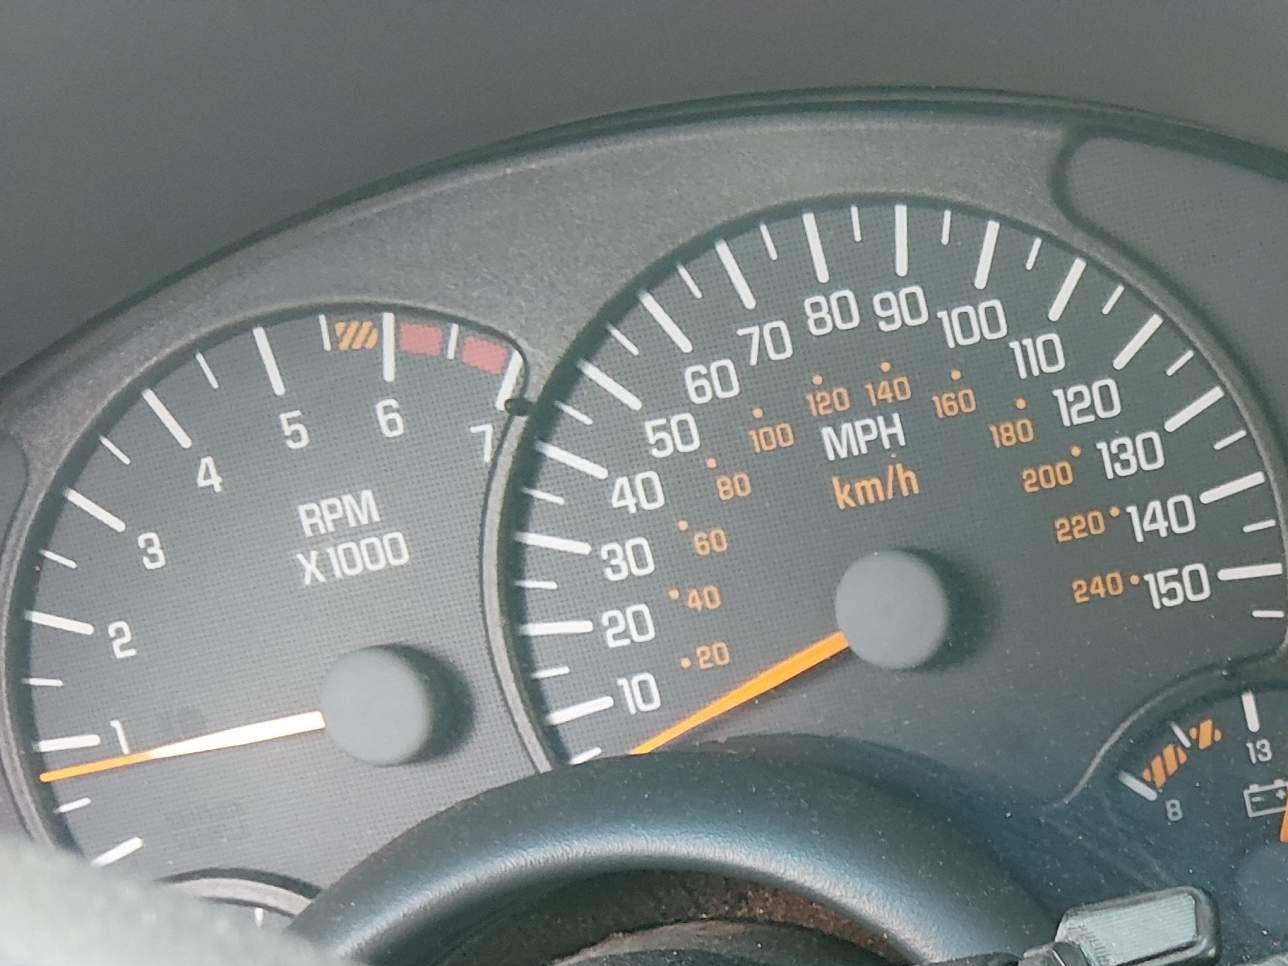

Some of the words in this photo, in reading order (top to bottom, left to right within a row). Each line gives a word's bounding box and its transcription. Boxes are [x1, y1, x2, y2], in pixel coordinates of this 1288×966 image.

[804, 289, 859, 335] 80
[873, 286, 928, 331] 90
[937, 299, 1007, 348] 100
[737, 321, 792, 365] 70
[1009, 333, 1065, 378] 110
[684, 359, 739, 404] 60
[865, 377, 911, 406] 140
[376, 399, 404, 437] 6
[806, 387, 849, 416] 120
[932, 389, 976, 417] 160
[1053, 378, 1121, 426] 120
[279, 410, 309, 449] 5
[469, 424, 493, 463] 7
[644, 413, 700, 457] 50
[748, 424, 794, 452] 100
[821, 413, 905, 460] MPH
[990, 419, 1033, 448] 180
[197, 457, 222, 492] 4
[1096, 431, 1164, 479] 130
[611, 471, 664, 513] 40
[717, 472, 751, 500] 80
[832, 464, 918, 509] km/h
[1023, 462, 1073, 492] 200
[298, 490, 380, 537] RPM
[1055, 511, 1104, 541] 220
[1126, 495, 1195, 542] 140
[138, 533, 165, 569] 3
[296, 532, 409, 585] X1000
[601, 538, 654, 581] 30
[693, 529, 728, 555] 60
[687, 585, 721, 611] 40
[1072, 572, 1123, 603] 240
[1144, 563, 1210, 609] 150
[108, 621, 136, 658] 2
[601, 604, 655, 648] 20
[696, 642, 729, 669] 20
[617, 673, 660, 714] 10
[108, 718, 130, 753] 1
[1246, 739, 1272, 763] 13
[1166, 799, 1182, 820] 8
